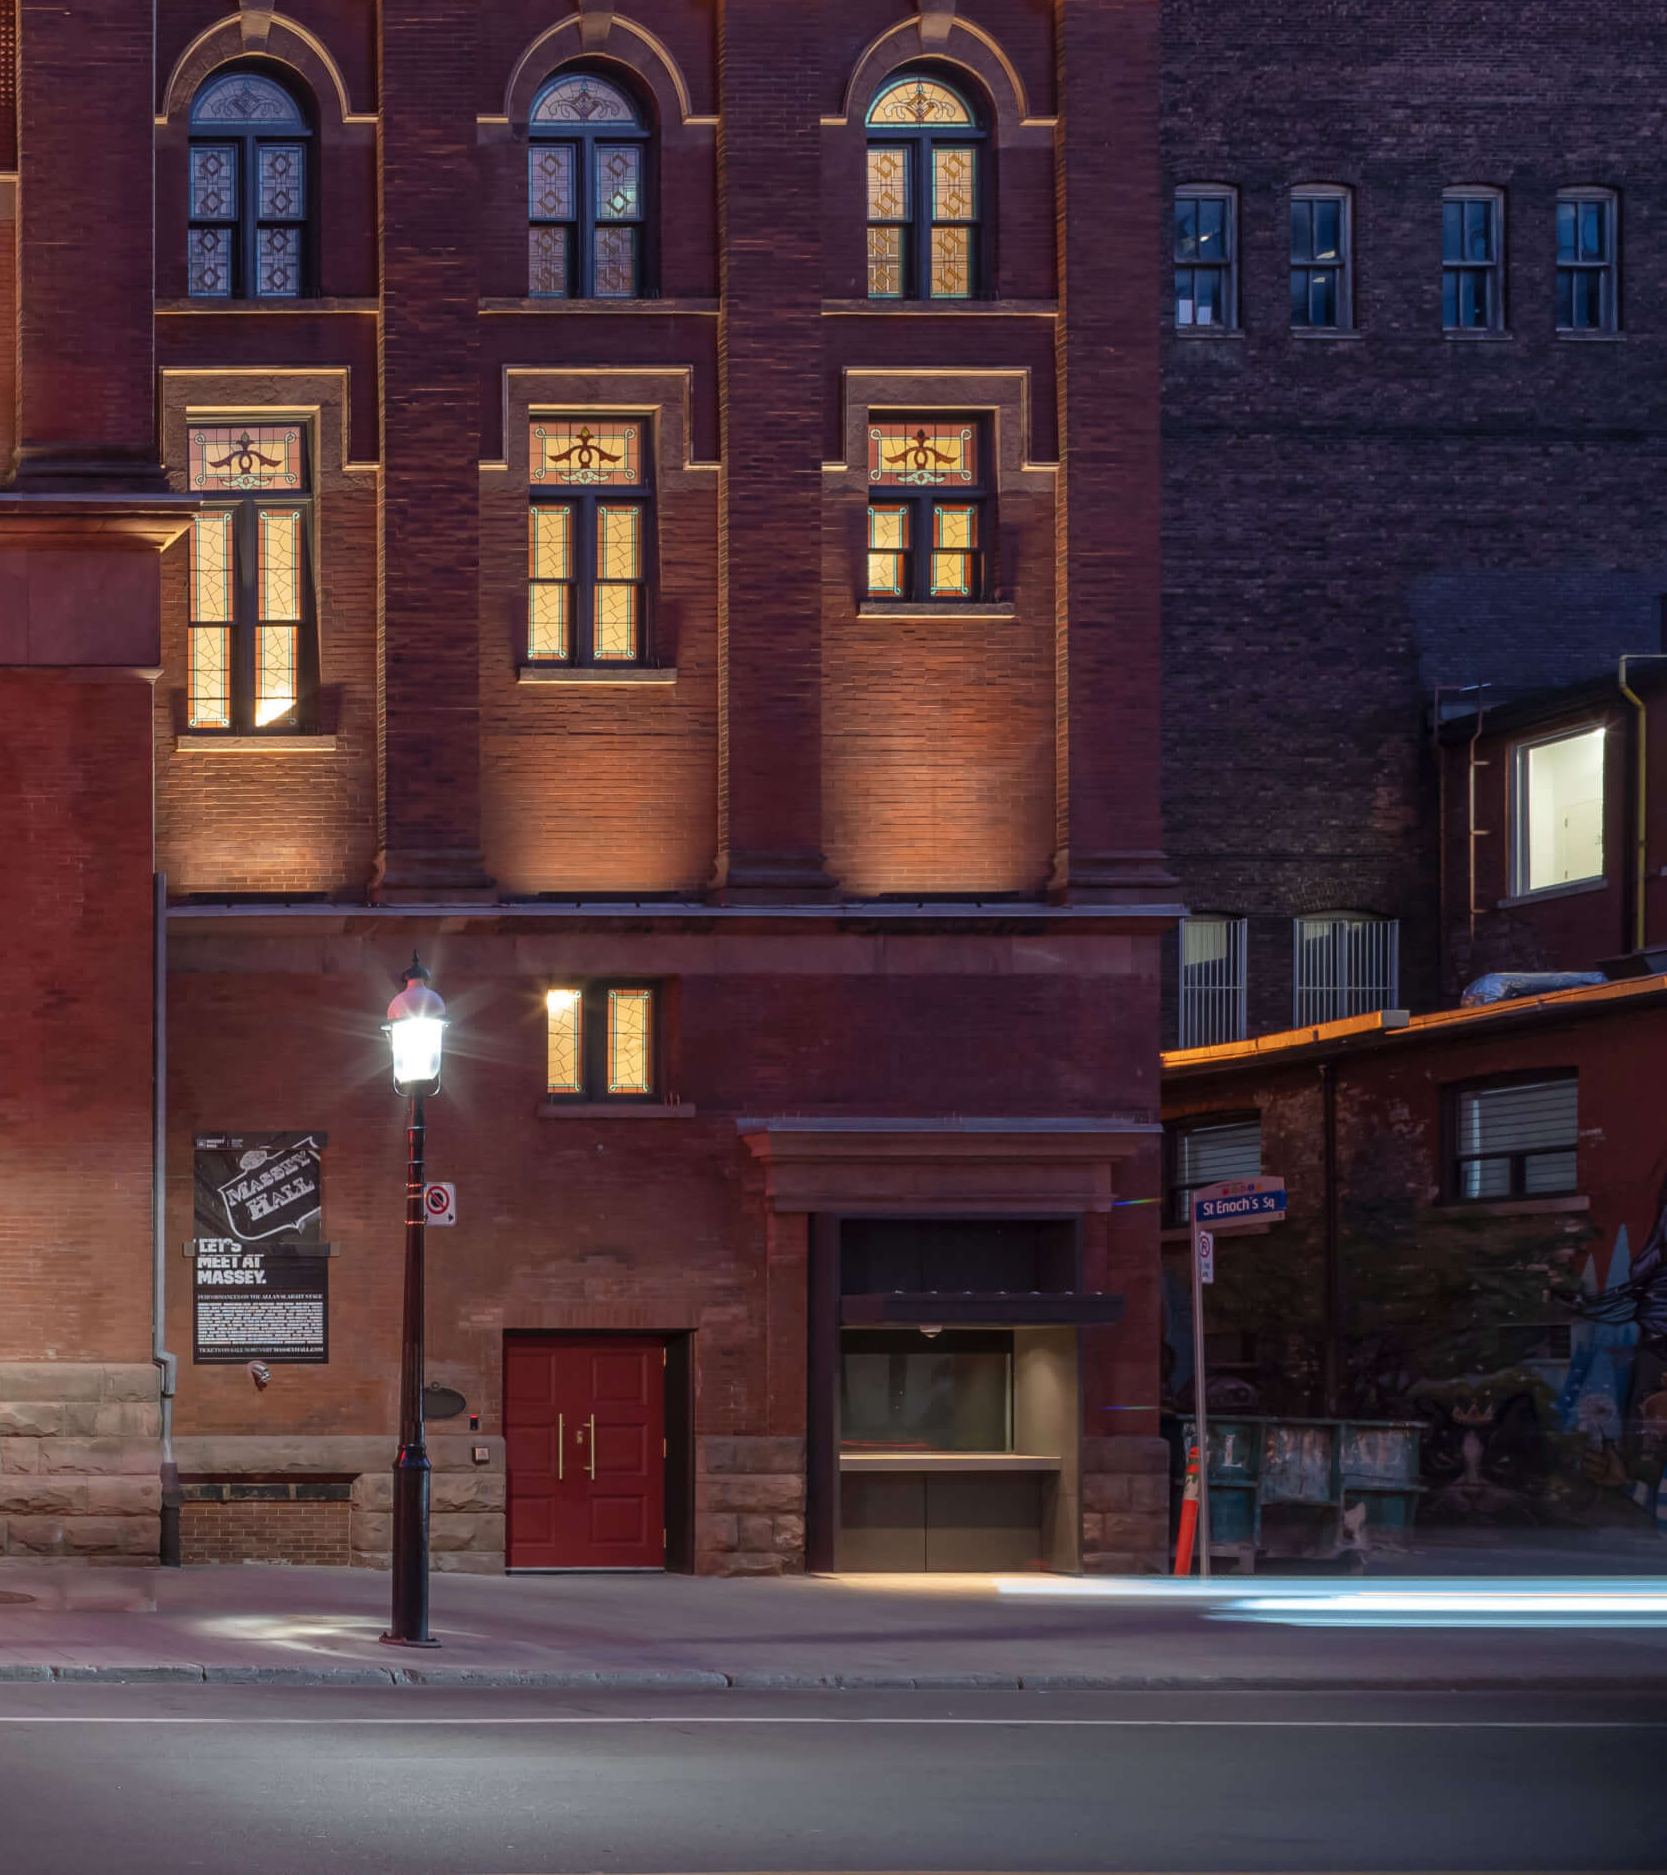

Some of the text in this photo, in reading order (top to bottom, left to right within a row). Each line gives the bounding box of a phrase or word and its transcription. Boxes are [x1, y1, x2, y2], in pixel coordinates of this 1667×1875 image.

[226, 1150, 311, 1207] MASSEY
[245, 1177, 316, 1221] HALL
[1202, 1196, 1275, 1216] St Enoch's Sq
[199, 1238, 242, 1253] LET'S
[197, 1254, 264, 1268] MEET AT
[197, 1270, 267, 1285] MASSEY.
